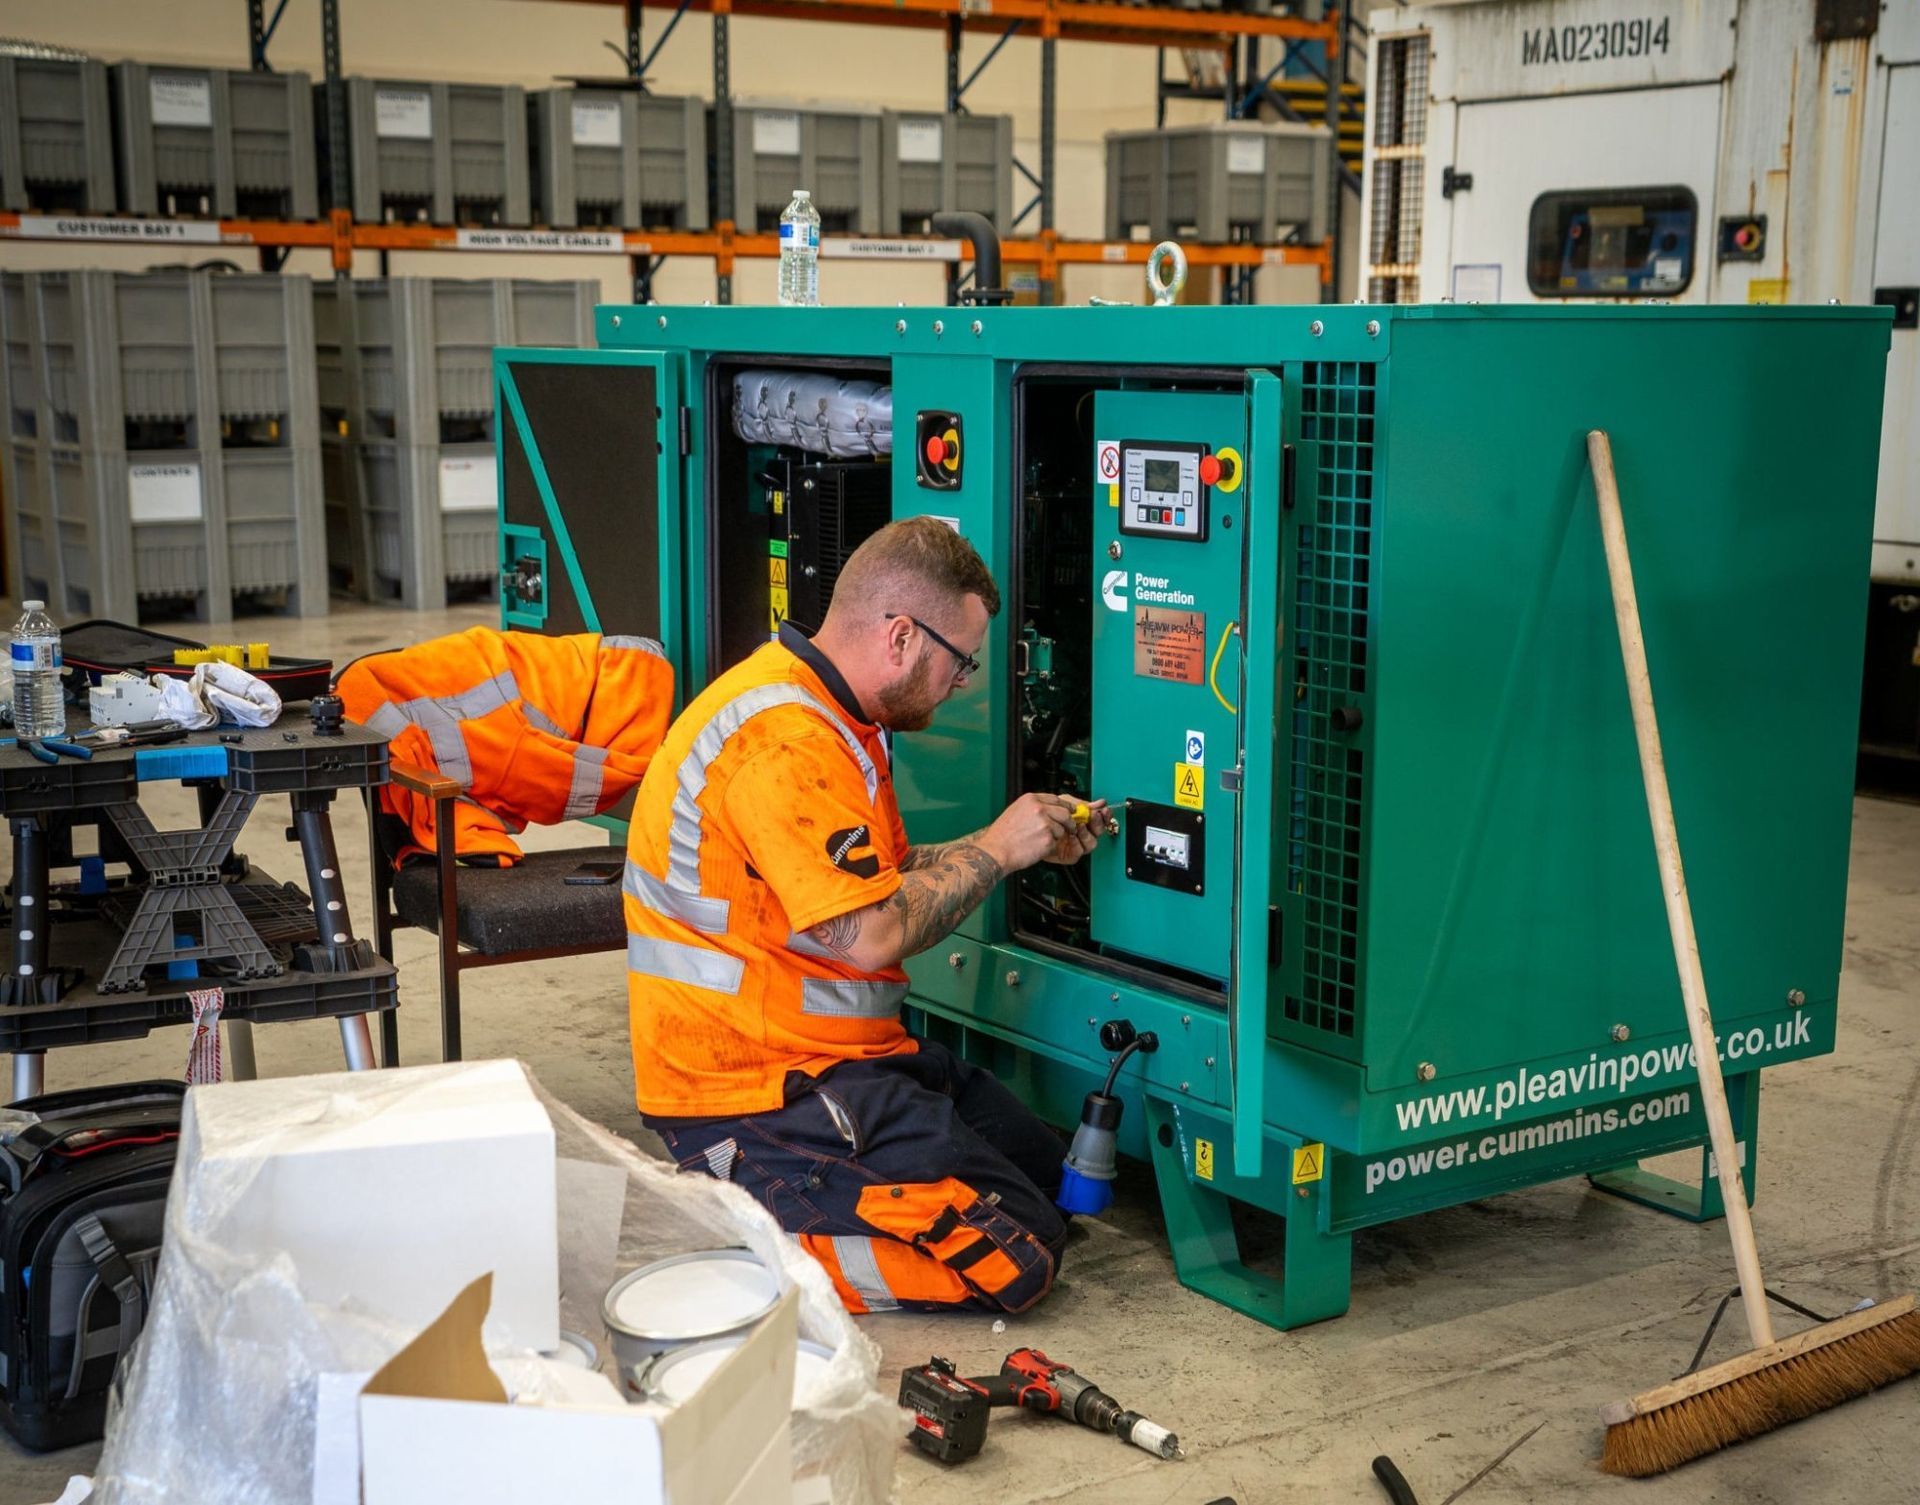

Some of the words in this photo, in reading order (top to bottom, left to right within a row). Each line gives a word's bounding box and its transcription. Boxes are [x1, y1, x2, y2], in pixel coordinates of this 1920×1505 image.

[1522, 16, 1670, 66] MA0230914
[56, 220, 140, 235] CUSTOMER
[144, 222, 172, 235] BAY
[177, 223, 185, 235] 1
[505, 235, 560, 246] VOLTAGE
[564, 236, 611, 247] CABLES
[1135, 572, 1169, 589] Power
[1135, 586, 1195, 605] Generation
[1171, 624, 1200, 636] POWER
[1396, 1010, 1812, 1131] www.pleavinpow.co.uk
[1366, 1091, 1690, 1195] power.cummins.com
